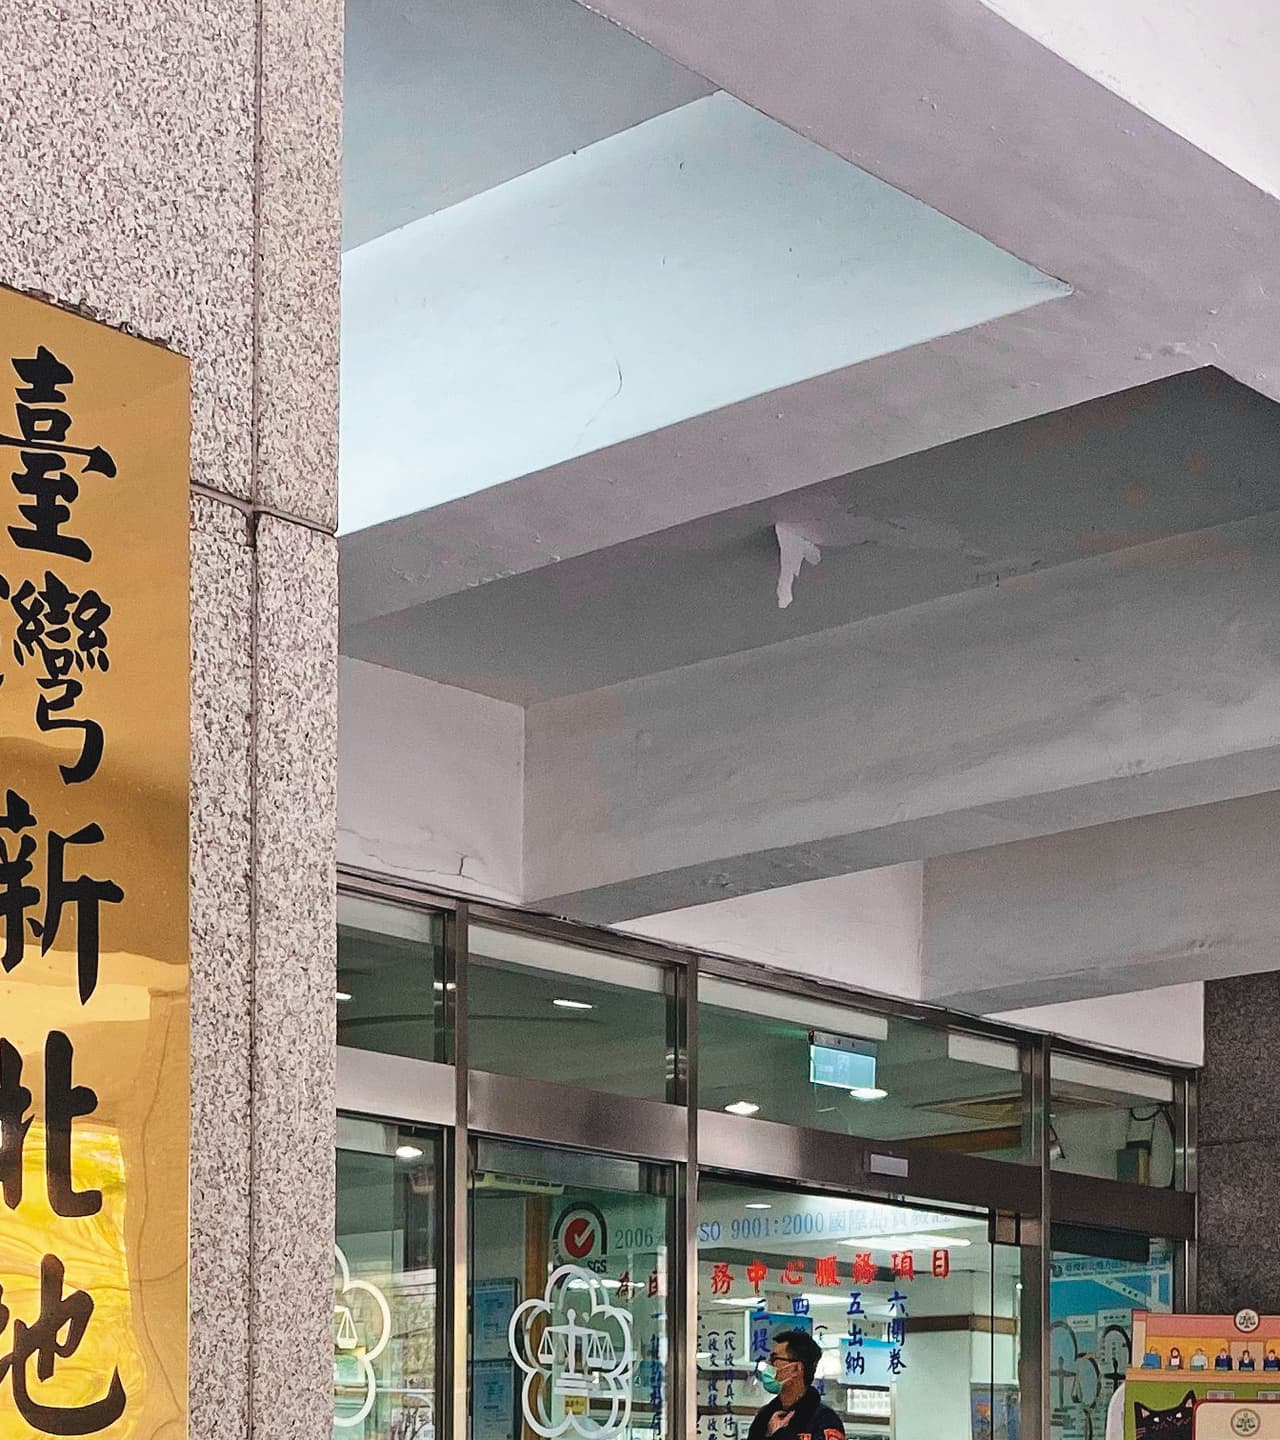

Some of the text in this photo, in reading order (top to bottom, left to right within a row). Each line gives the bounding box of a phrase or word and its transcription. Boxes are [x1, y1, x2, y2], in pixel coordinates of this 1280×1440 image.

[615, 1226, 663, 1249] 2006
[696, 1221, 721, 1243] SO
[587, 1260, 607, 1274] SGS
